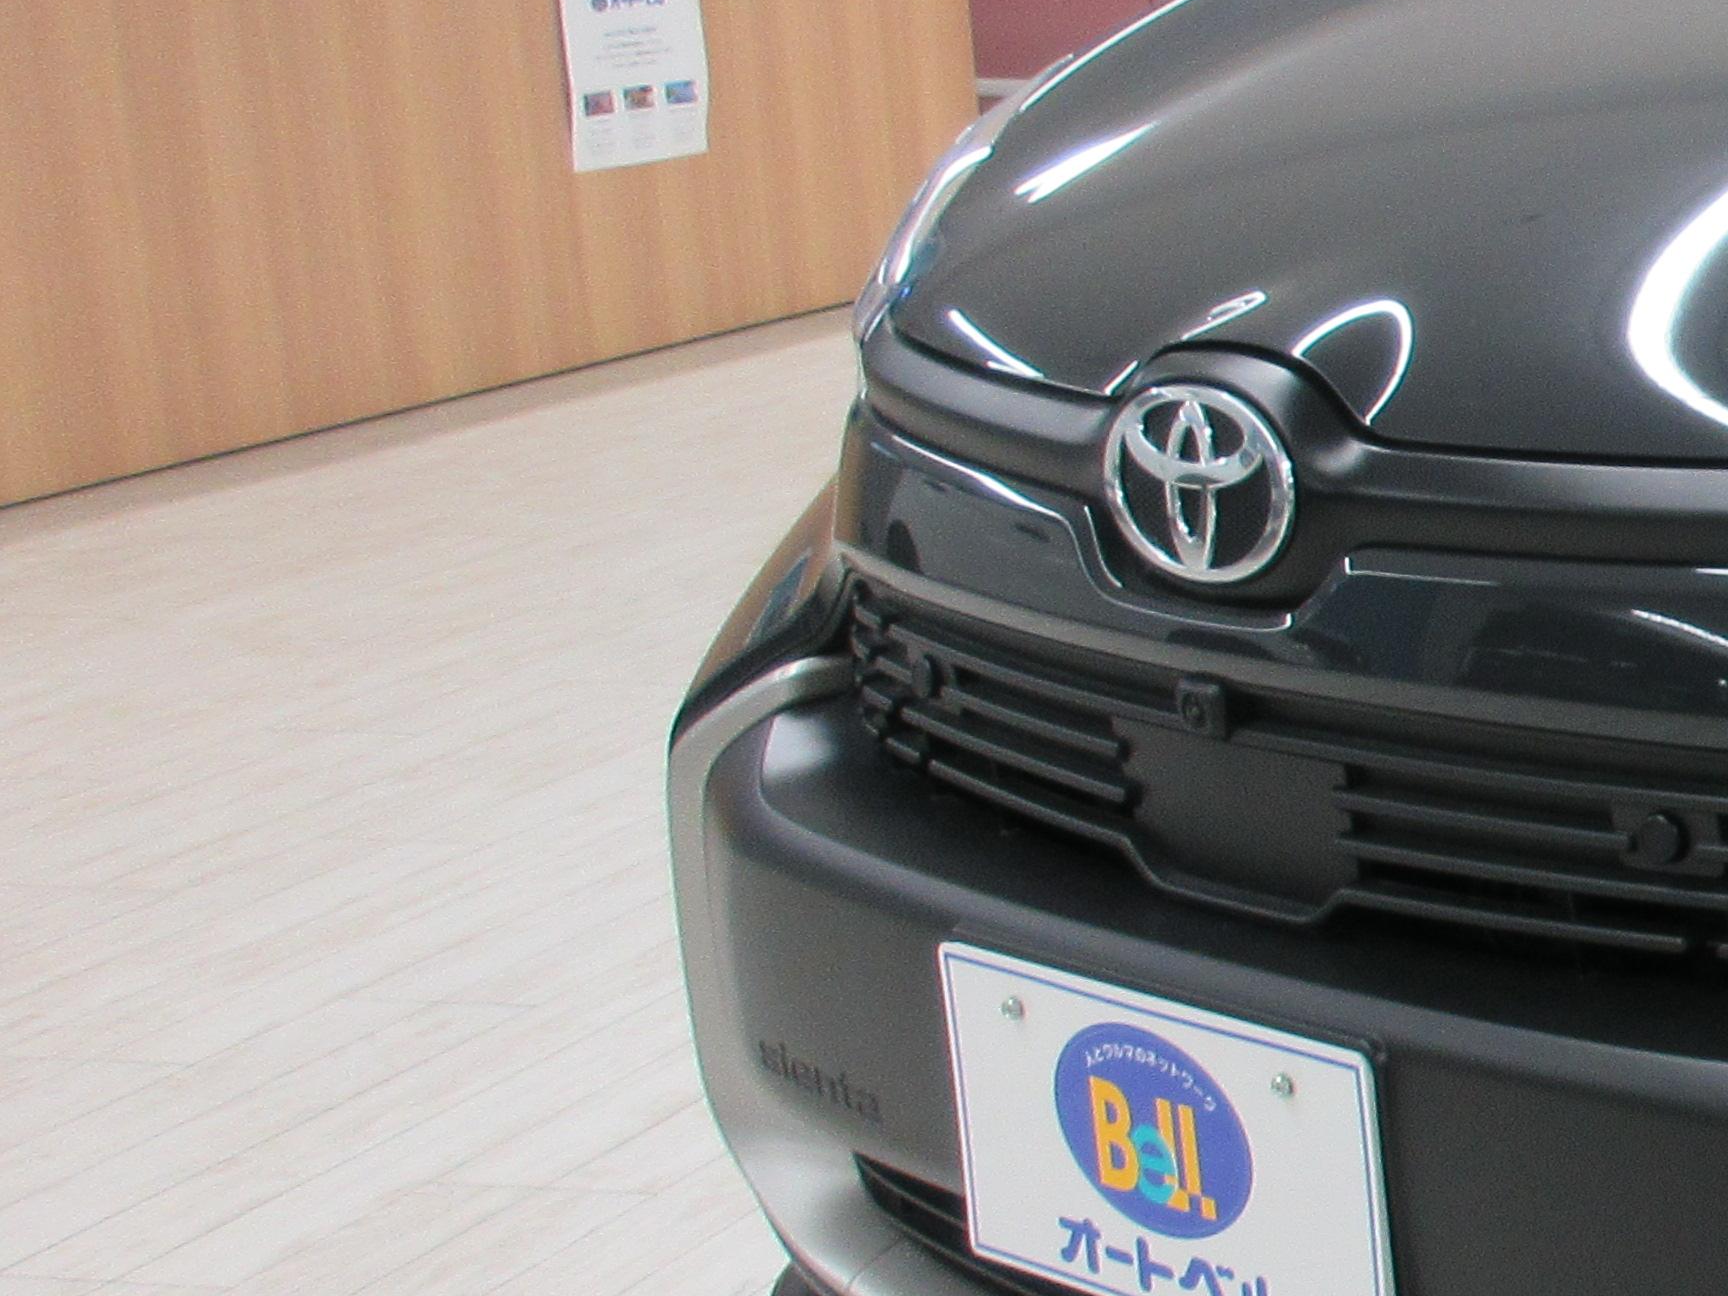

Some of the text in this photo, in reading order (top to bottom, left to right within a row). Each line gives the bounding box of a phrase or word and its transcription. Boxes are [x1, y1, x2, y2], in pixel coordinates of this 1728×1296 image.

[1085, 1042, 1217, 1112] 人とクルマのネットワーク
